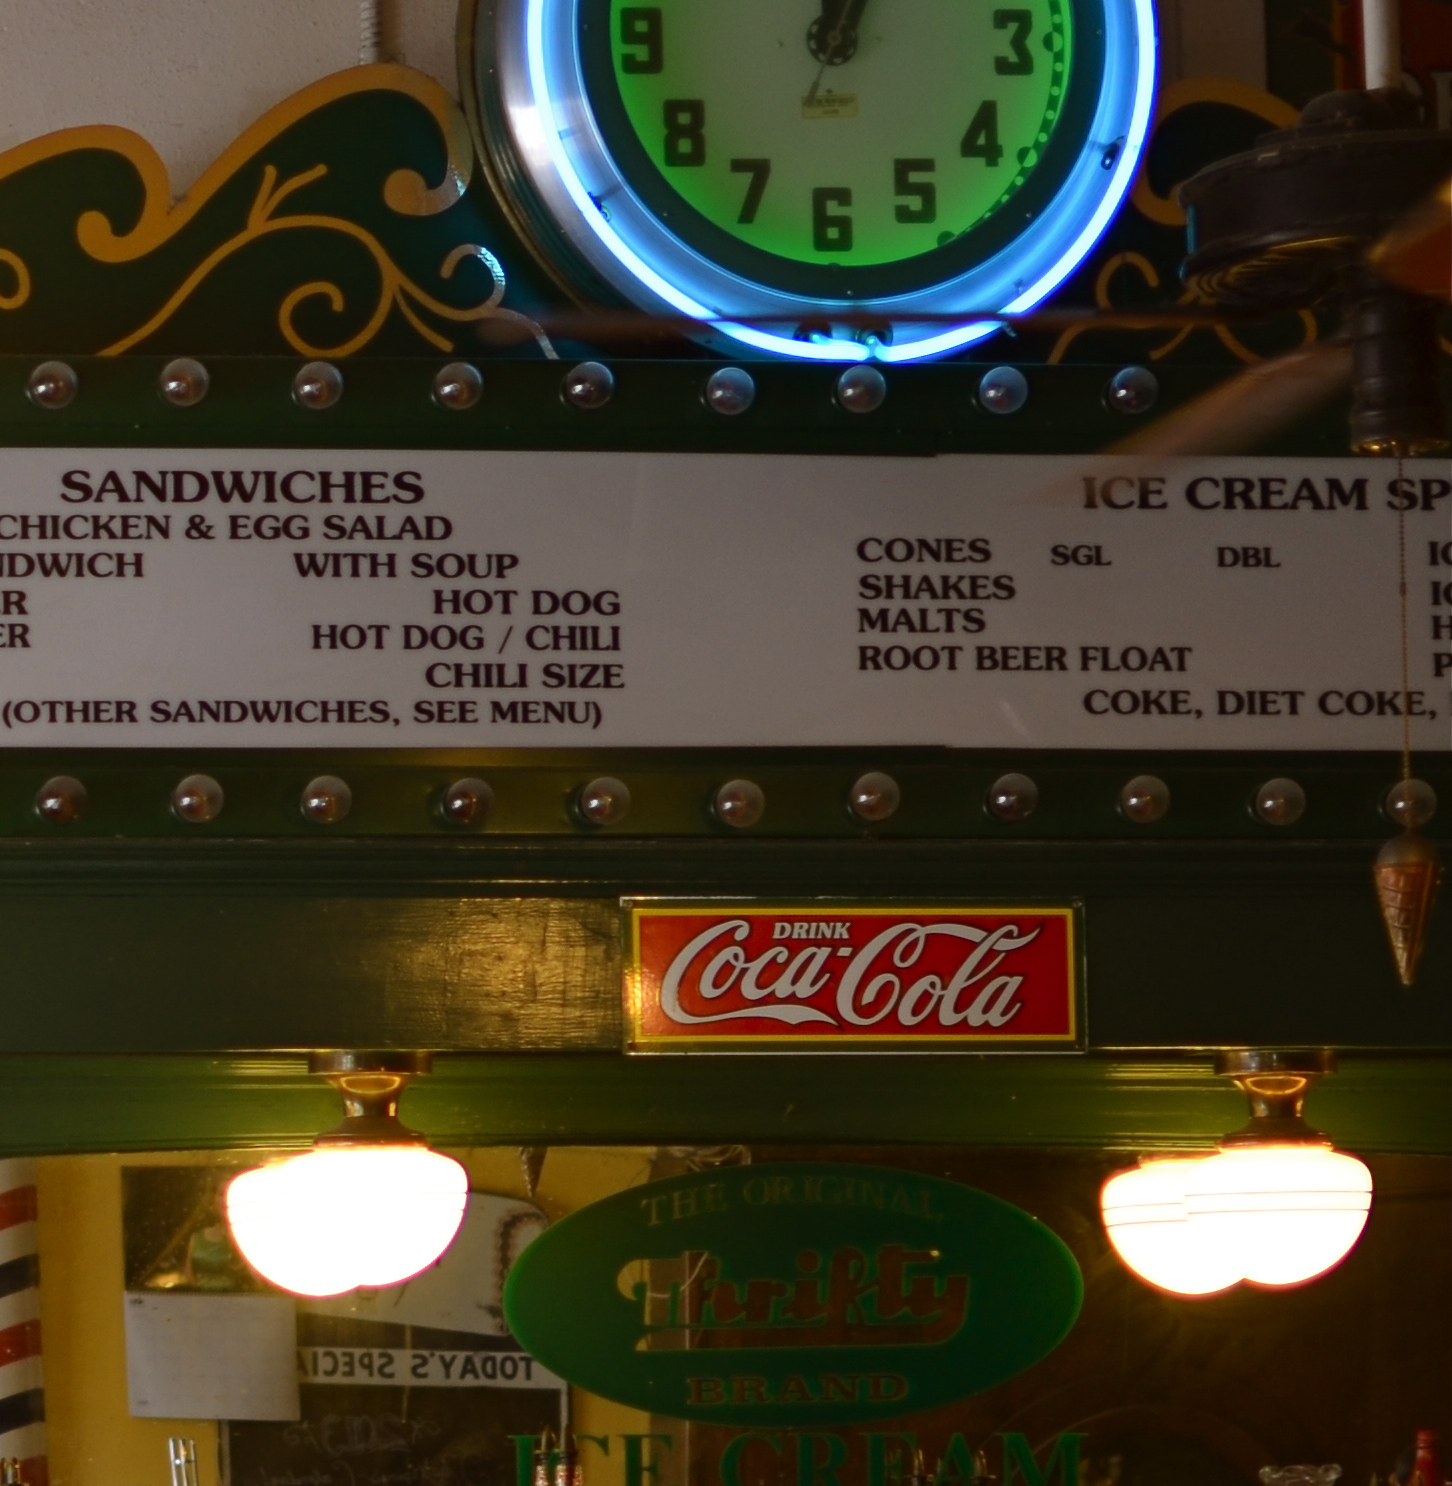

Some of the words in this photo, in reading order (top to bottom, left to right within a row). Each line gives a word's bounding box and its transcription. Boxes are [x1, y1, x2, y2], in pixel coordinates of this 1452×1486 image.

[619, 7, 664, 75] 9
[993, 8, 1033, 77] 3
[663, 99, 705, 167] 8
[960, 100, 1003, 167] 4
[730, 158, 771, 225] 7
[894, 158, 936, 224] 5
[812, 187, 853, 252] 6
[61, 470, 425, 504] SANDWICHES
[1083, 476, 1168, 510] ICE
[1185, 477, 1368, 511] CREAM
[185, 515, 215, 540] &
[229, 515, 310, 540] EGG
[323, 515, 453, 540] SALAD
[294, 553, 396, 578] WITH
[411, 553, 519, 578] SOUP
[856, 538, 992, 563] CONES
[1051, 545, 1111, 566] SGL
[1217, 547, 1281, 568] DBL
[859, 574, 1016, 600] SHAKES
[434, 590, 518, 615] HOT
[532, 590, 620, 616] DOG
[858, 608, 986, 633] MALTS
[312, 624, 390, 649] HOT
[403, 625, 484, 650] DOG
[498, 626, 513, 654] /
[526, 625, 620, 651] CHILI
[859, 645, 963, 671] ROOT
[976, 646, 1068, 671] BEER
[1080, 646, 1192, 672] FLOAT
[425, 663, 528, 688] CHILI
[542, 663, 624, 688] SIZE
[2, 701, 138, 728] (OTHER
[150, 700, 400, 726] SANDWICHES,
[414, 701, 478, 723] SEE
[491, 701, 602, 729] MENU)
[1083, 689, 1203, 719] COKE,
[1217, 690, 1305, 715] DIET
[1318, 690, 1438, 720] COKE,
[772, 922, 852, 940] DRINK
[641, 1181, 731, 1228] THE
[742, 1174, 943, 1224] ORIGINAL
[616, 1245, 972, 1353] Thrifty
[688, 1374, 909, 1407] BRAND
